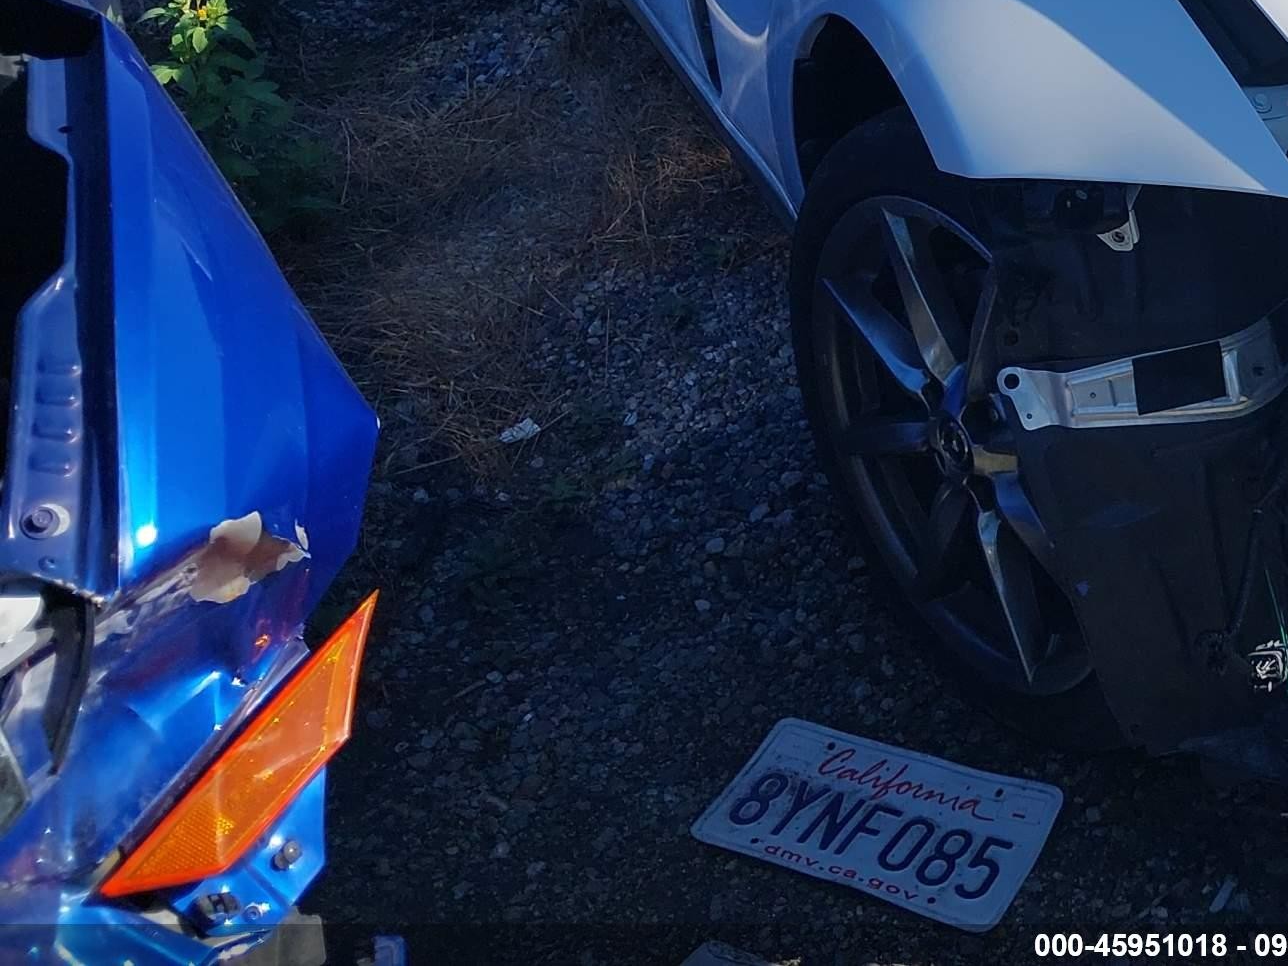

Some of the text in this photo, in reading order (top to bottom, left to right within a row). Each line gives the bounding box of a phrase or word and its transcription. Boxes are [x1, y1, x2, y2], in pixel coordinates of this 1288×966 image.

[817, 748, 995, 822] California
[728, 772, 1014, 900] 8YNF085
[763, 843, 918, 901] dmv.ca.gov
